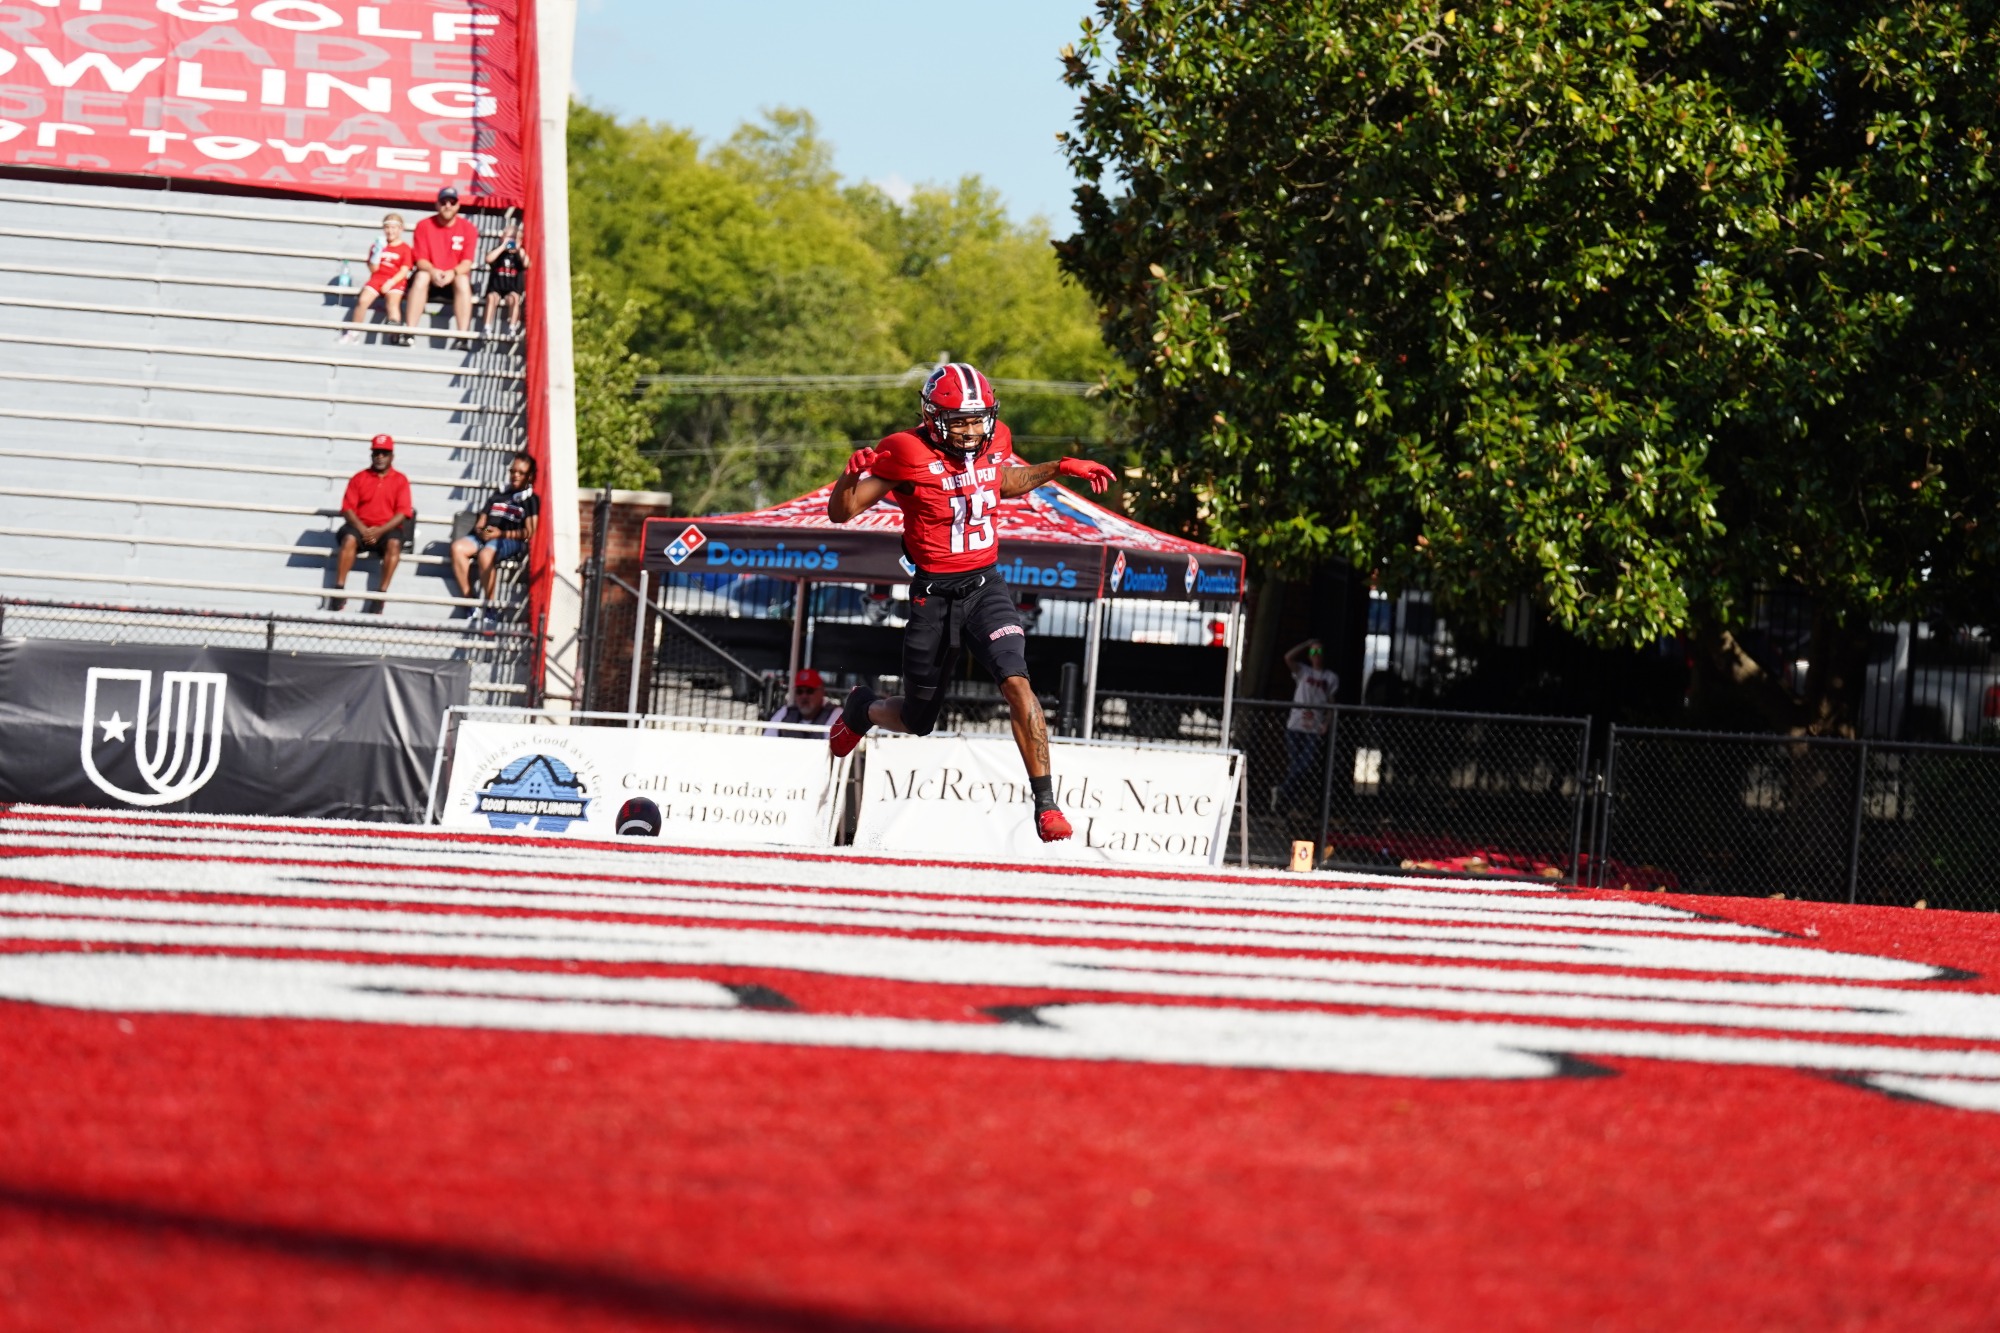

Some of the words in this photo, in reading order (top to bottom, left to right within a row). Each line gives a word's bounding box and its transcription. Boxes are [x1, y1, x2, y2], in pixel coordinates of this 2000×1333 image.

[155, 0, 500, 41] GOLF
[0, 46, 498, 118] WLING
[260, 106, 496, 150] TAG
[129, 128, 498, 178] TOWER
[976, 466, 997, 484] PEAY
[949, 489, 997, 553] 15
[706, 541, 840, 571] Domino's
[995, 557, 1078, 589] mino's
[1123, 565, 1169, 592] Domino's
[1197, 568, 1237, 594] Domino's
[532, 734, 569, 749] Good
[621, 771, 669, 792] Call
[679, 781, 703, 794] us
[712, 781, 777, 803] today
[786, 786, 808, 801] at
[880, 767, 1102, 814] McReynlds
[1115, 778, 1212, 817] Nave
[480, 796, 506, 812] GOOD
[506, 798, 538, 815] WORKS
[536, 800, 583, 817] PLUMBING
[656, 803, 788, 827] 1-419-0980
[1084, 816, 1210, 857] Larson
